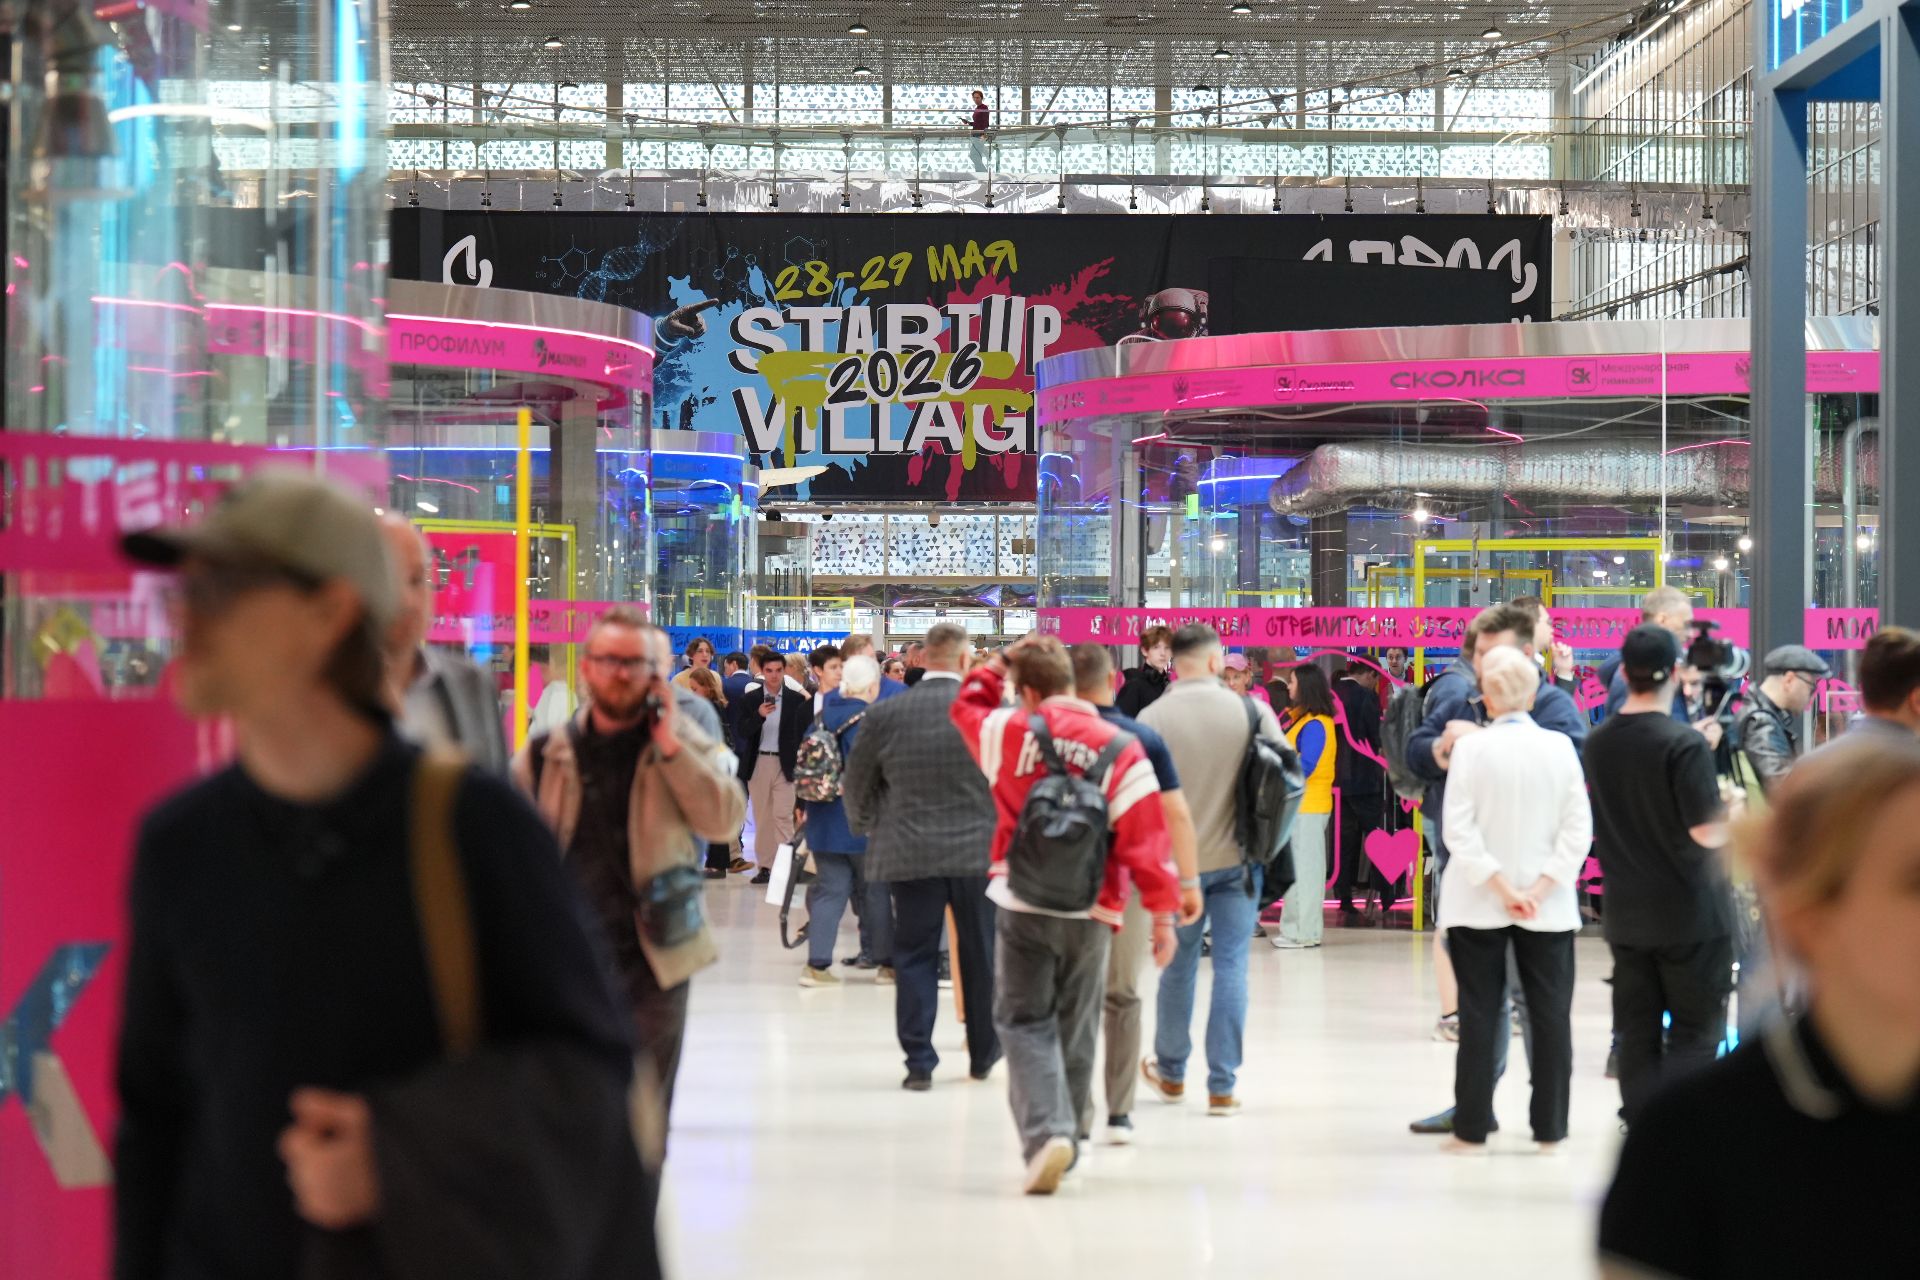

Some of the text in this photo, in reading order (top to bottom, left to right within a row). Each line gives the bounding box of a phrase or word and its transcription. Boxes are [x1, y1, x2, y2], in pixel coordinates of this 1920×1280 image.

[774, 239, 1018, 301] 28-29 МАЯ
[400, 332, 506, 357] ПРОФИЛУМ
[728, 293, 1062, 376] STARTUP
[824, 341, 984, 409] 2026
[1572, 366, 1591, 385] Sk
[732, 386, 1037, 455] VILLAG
